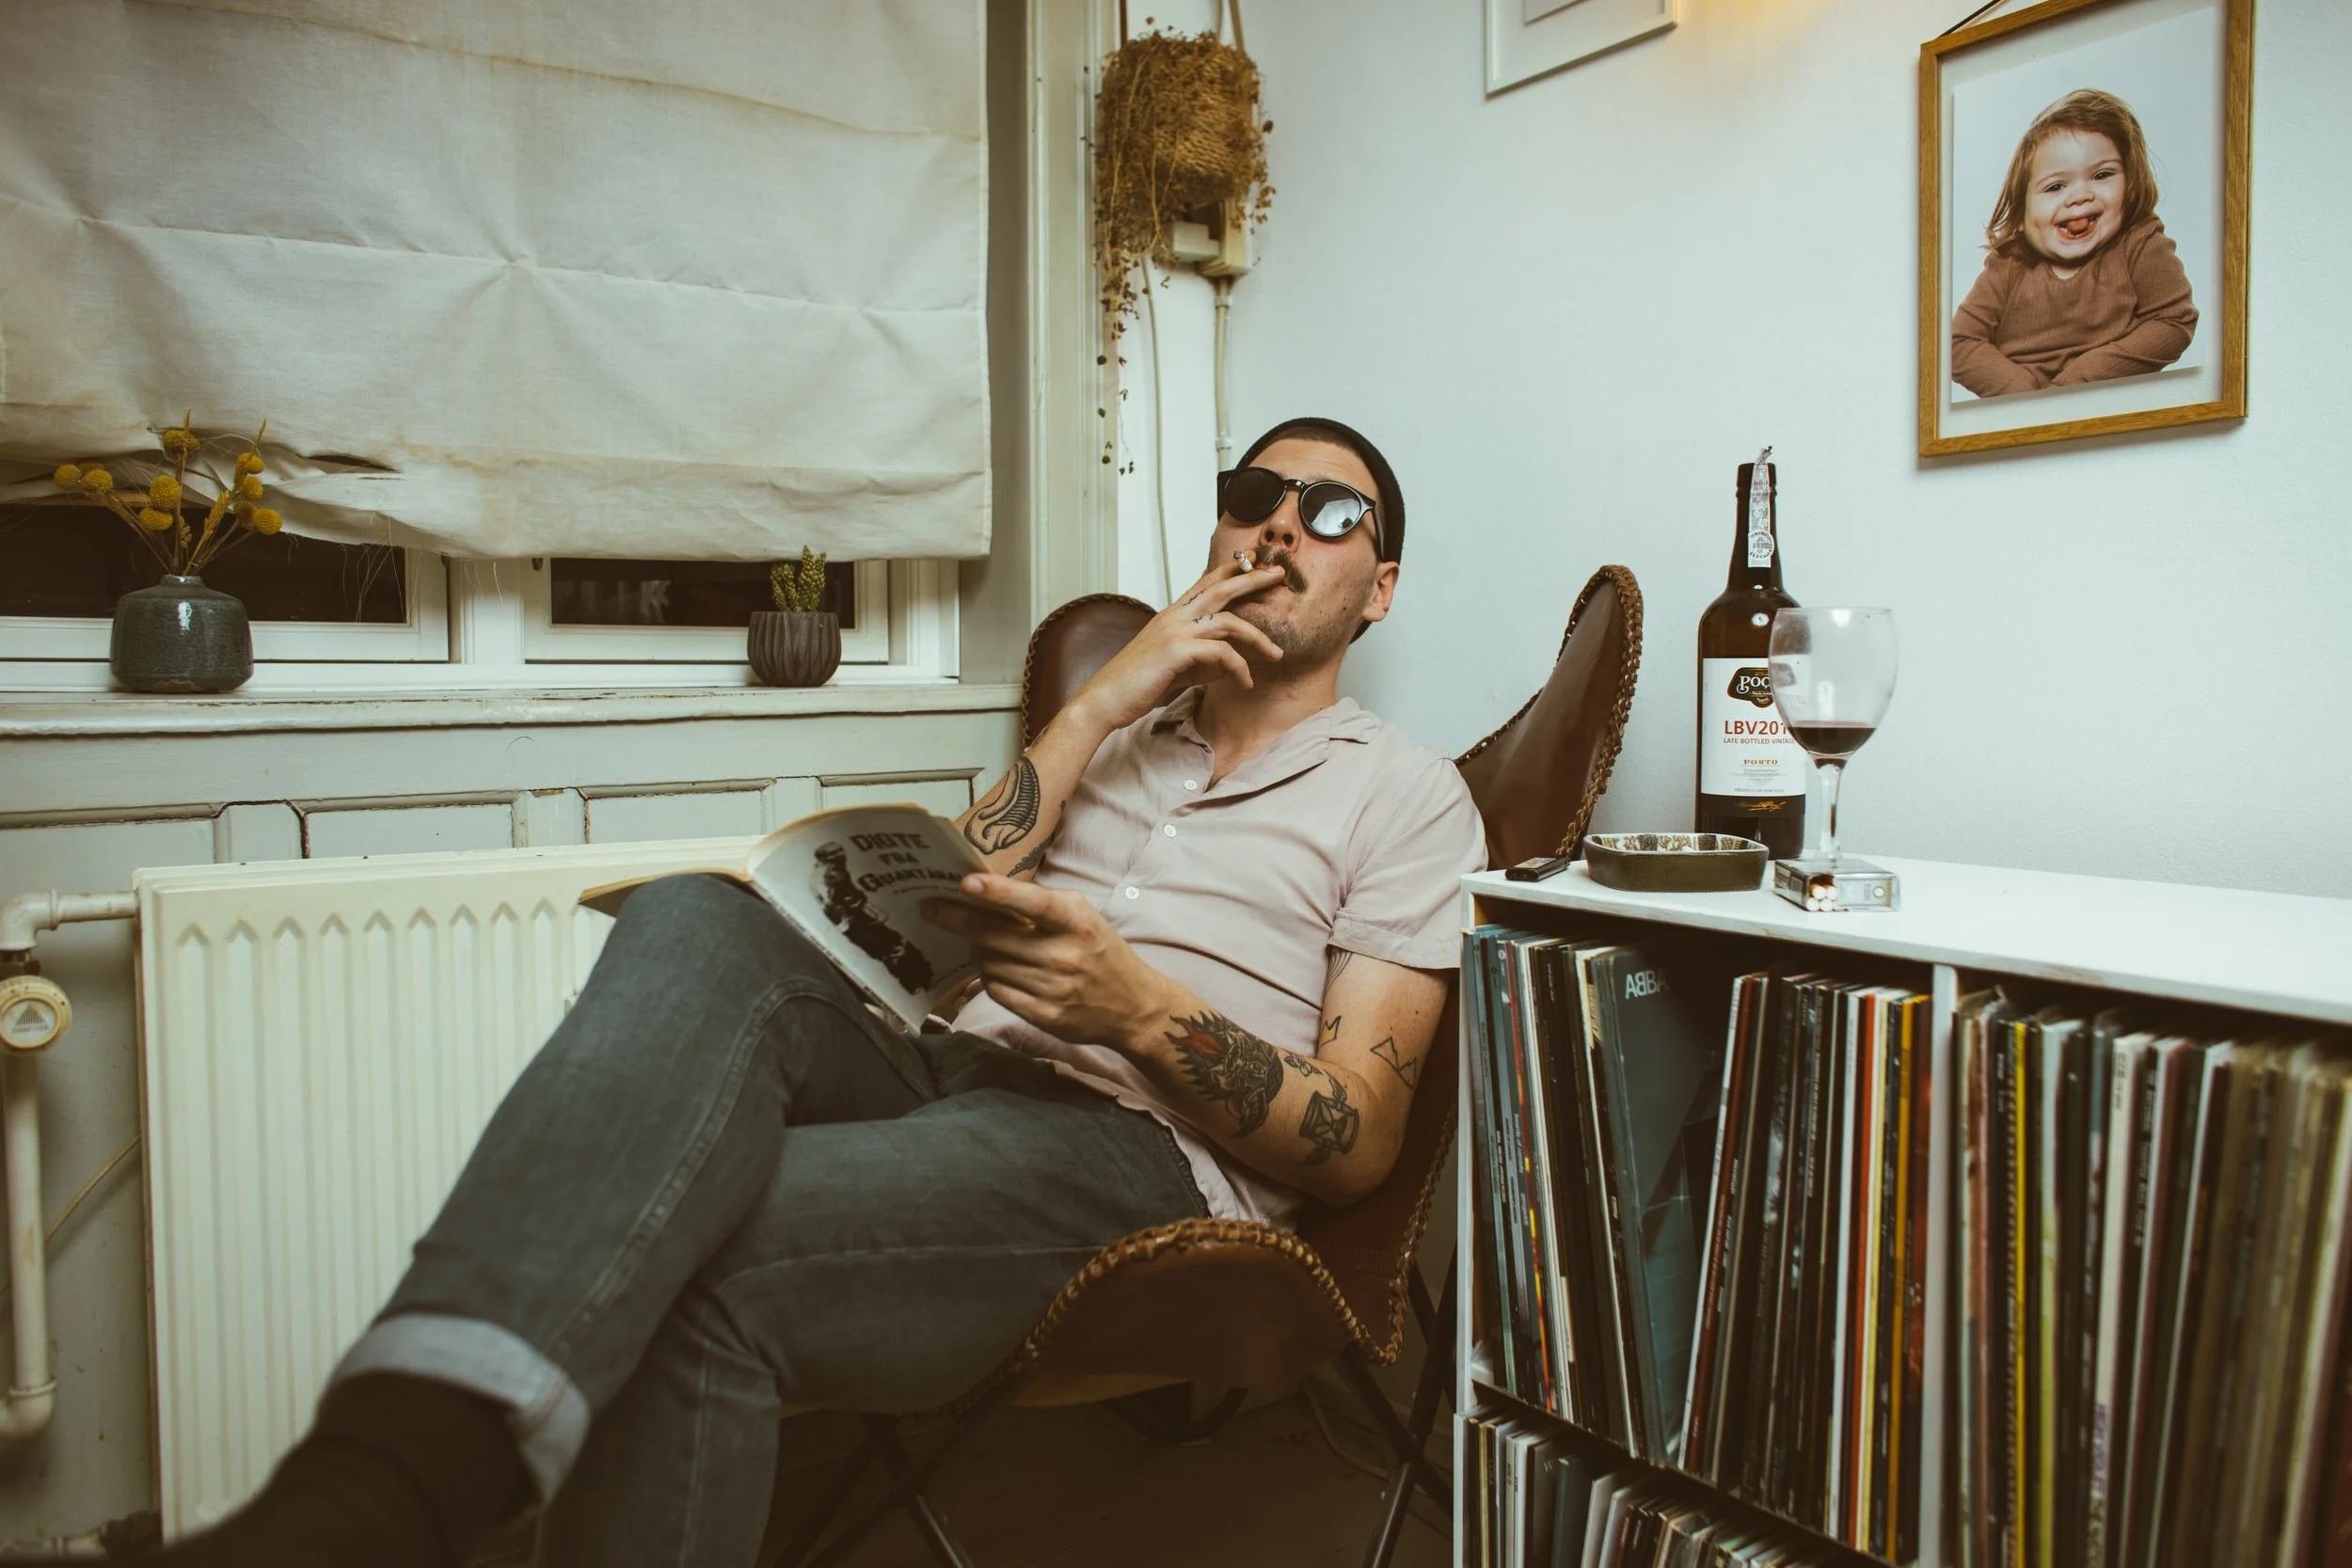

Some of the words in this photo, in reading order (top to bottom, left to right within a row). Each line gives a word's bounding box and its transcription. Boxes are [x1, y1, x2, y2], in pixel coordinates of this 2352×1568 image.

[1724, 721, 1787, 735] LBV201
[850, 832, 929, 852] DIGTE
[881, 852, 920, 867] FRA
[1625, 967, 1670, 1000] ABBA
